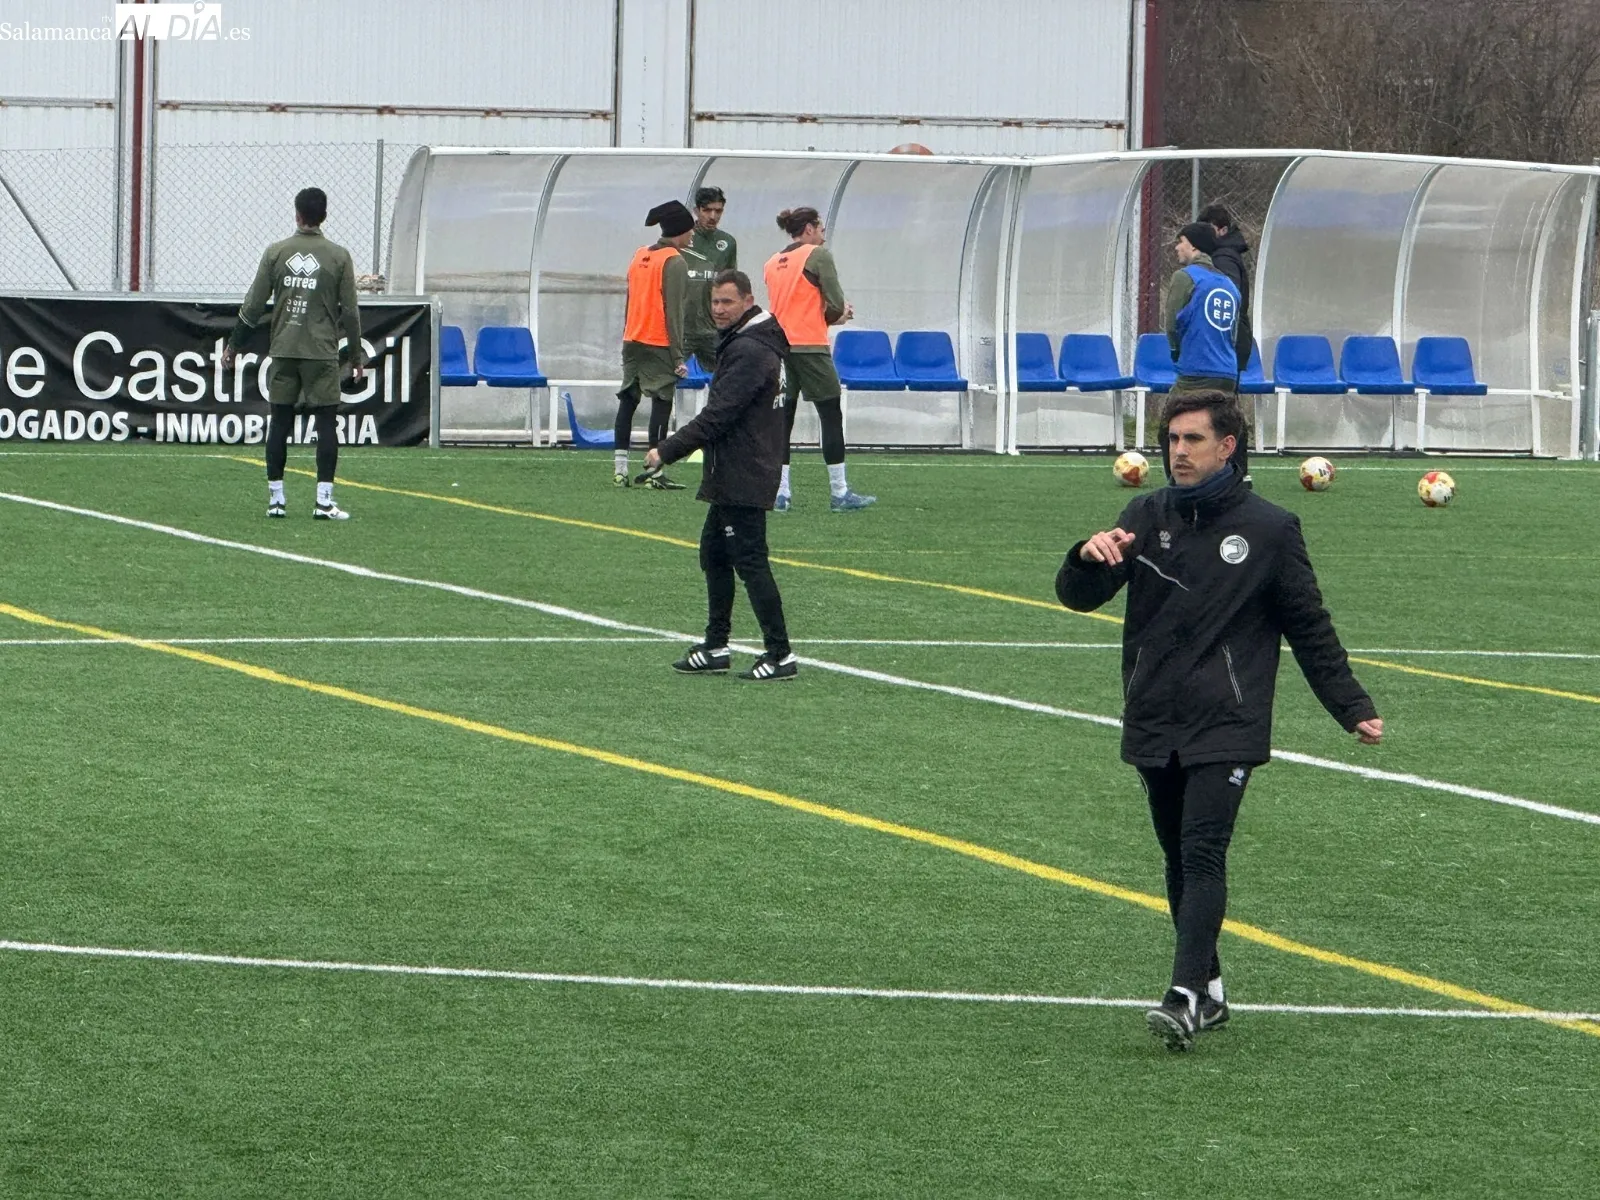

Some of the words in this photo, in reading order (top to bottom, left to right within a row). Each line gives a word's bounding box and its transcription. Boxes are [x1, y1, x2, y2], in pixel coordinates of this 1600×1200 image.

[283, 275, 317, 290] errea
[0, 346, 45, 398] e
[338, 336, 411, 404] Gil
[155, 413, 380, 445] INMOBIARIA
